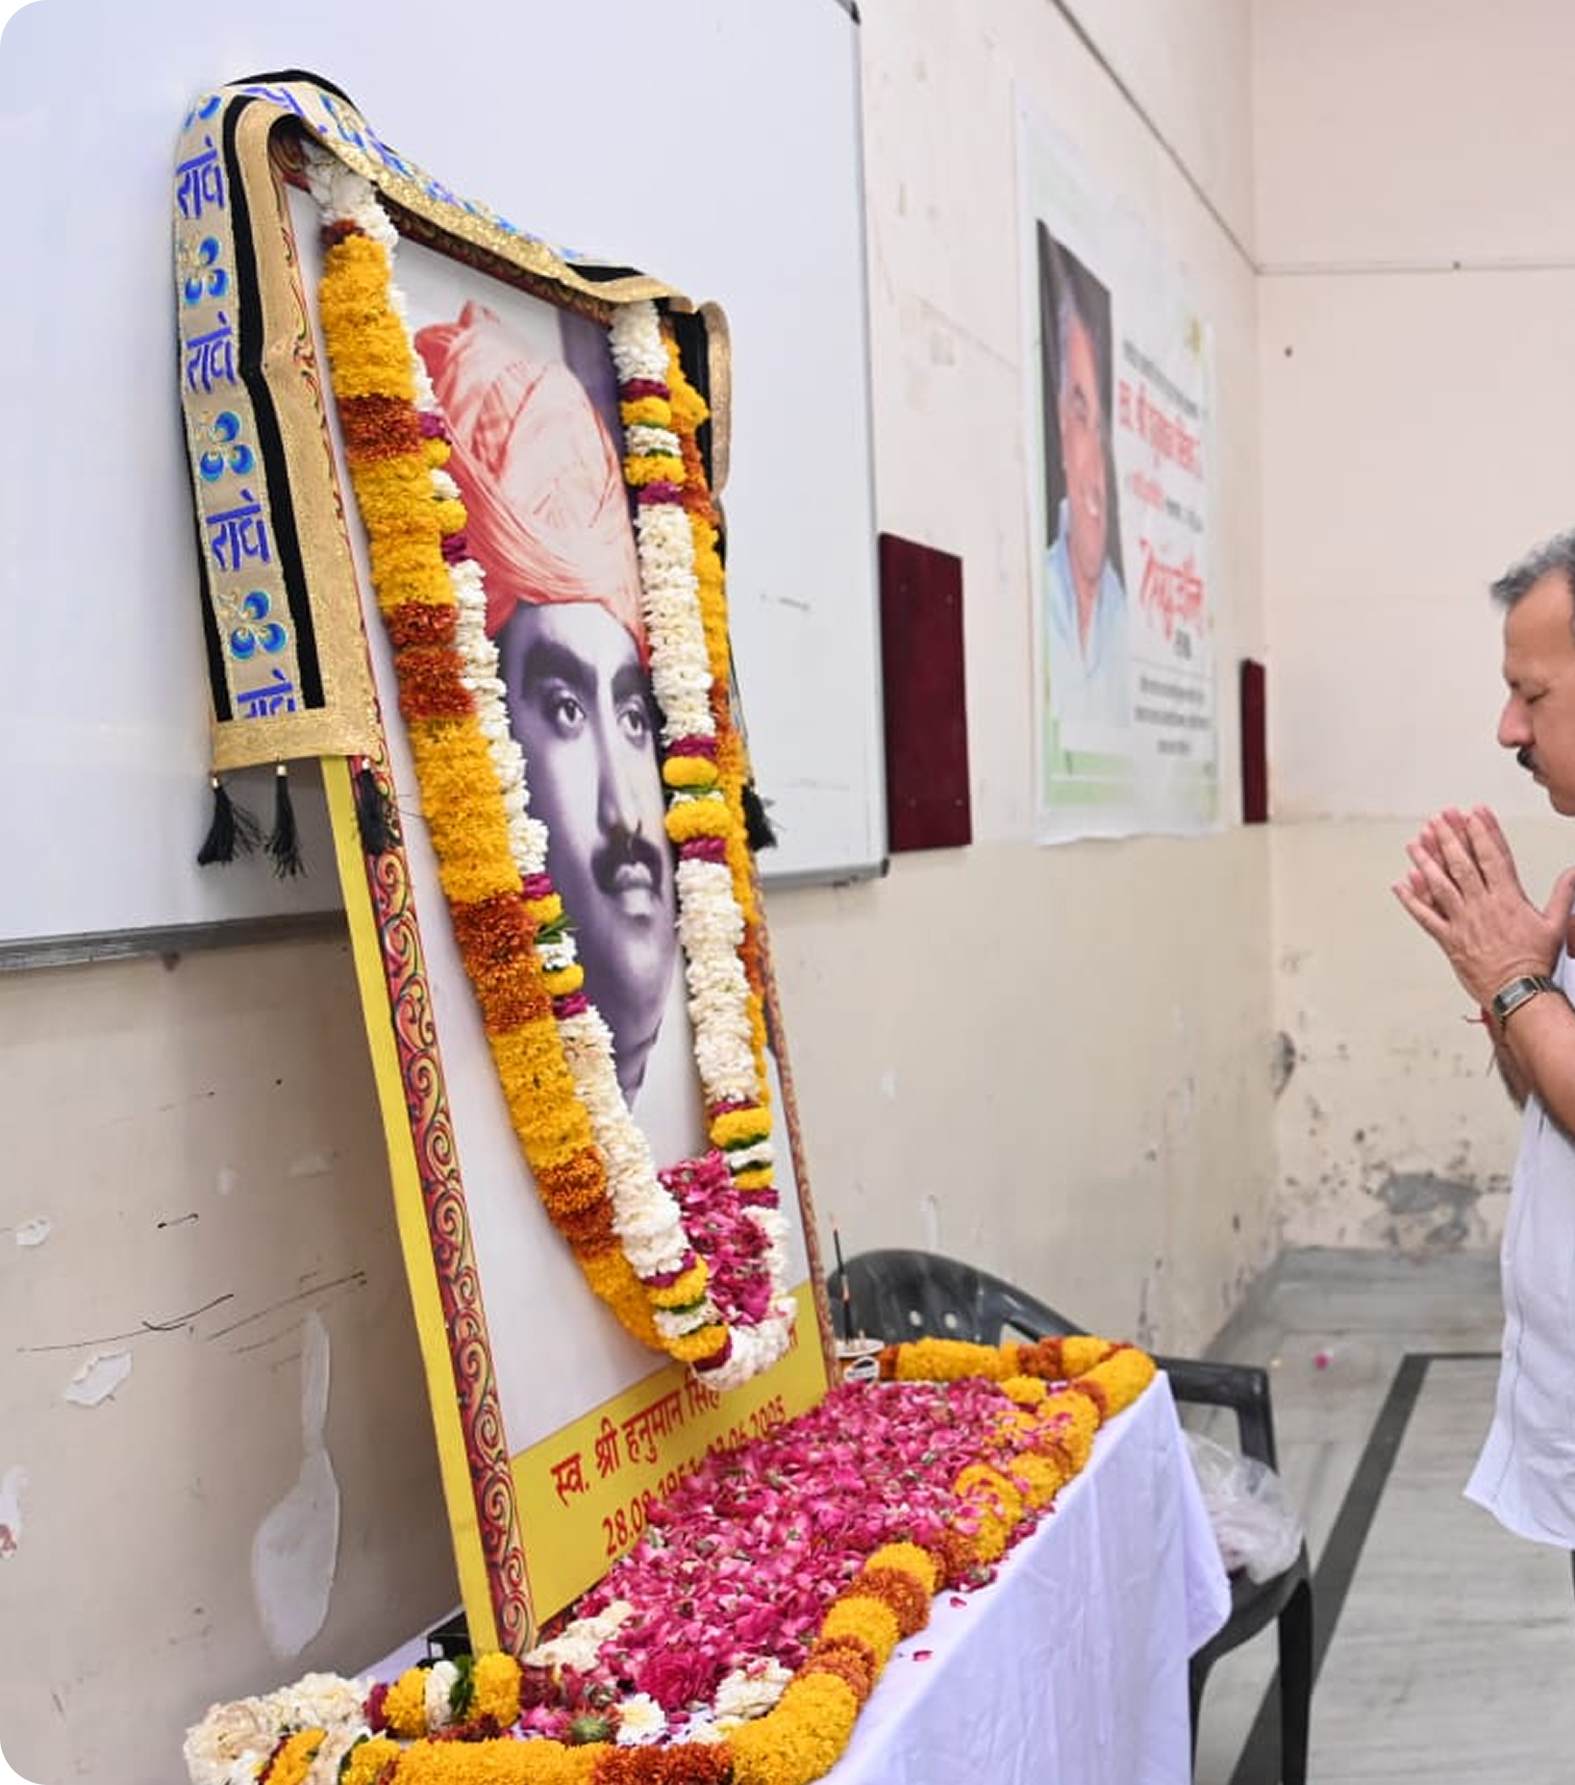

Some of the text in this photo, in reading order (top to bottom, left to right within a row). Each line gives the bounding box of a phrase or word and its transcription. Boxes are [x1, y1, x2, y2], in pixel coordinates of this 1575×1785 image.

[550, 1452, 590, 1507] स्व.
[595, 1417, 620, 1478] श्री
[621, 1389, 685, 1464] हनुमान
